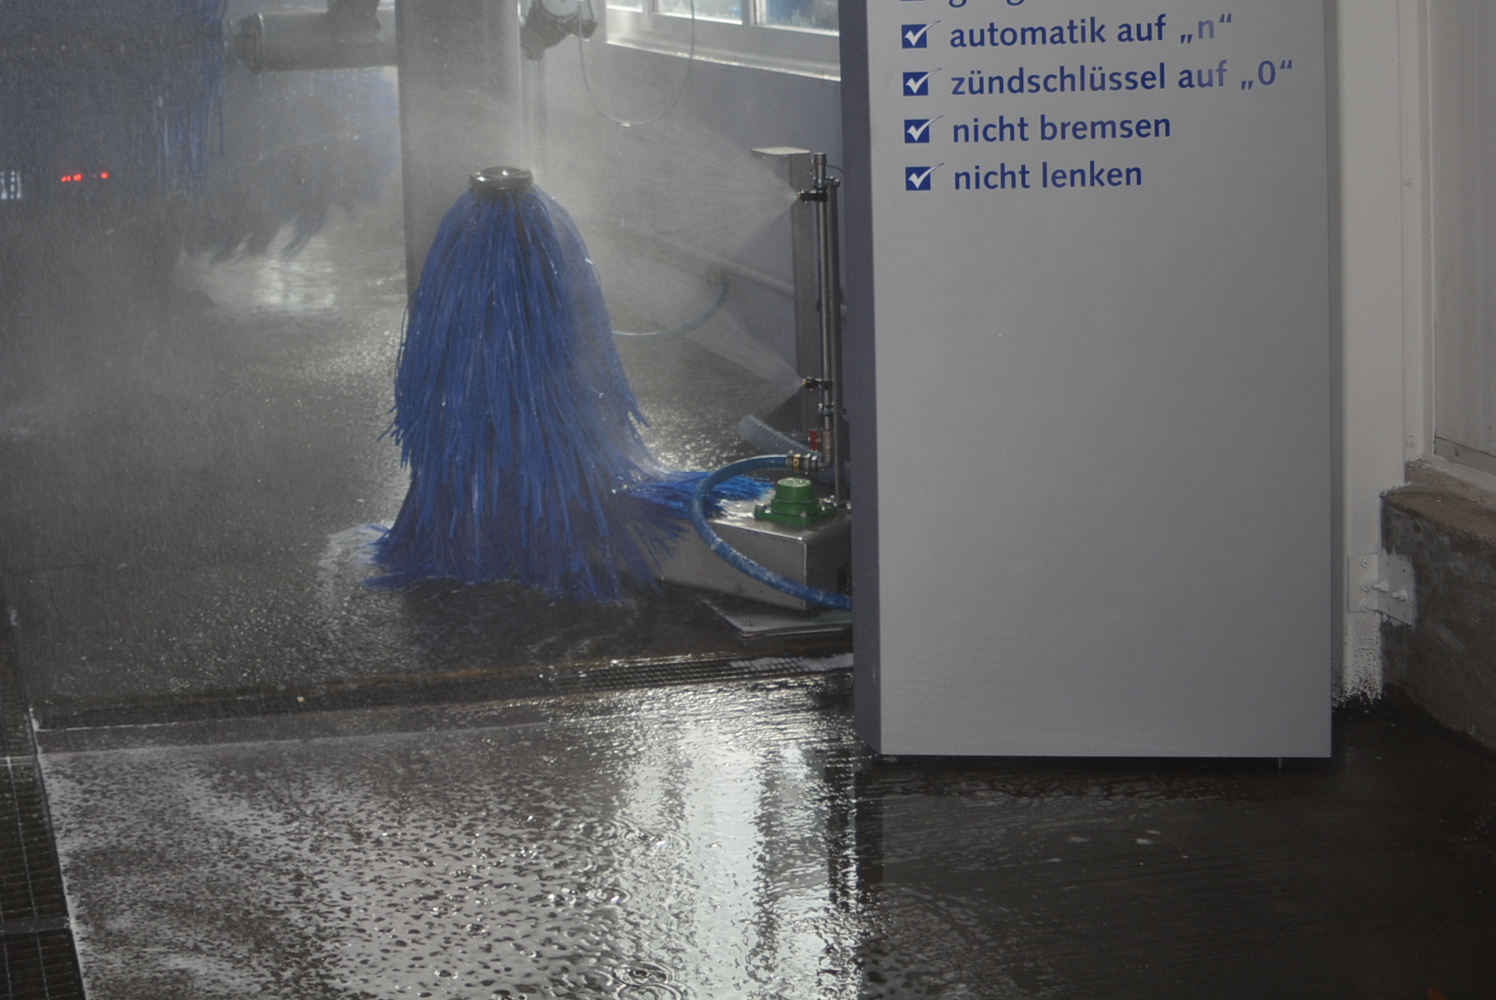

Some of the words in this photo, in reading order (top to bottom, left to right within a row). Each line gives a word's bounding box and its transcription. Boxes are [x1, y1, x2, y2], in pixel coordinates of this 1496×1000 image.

[949, 16, 1107, 48] automatik
[1117, 13, 1167, 42] auf
[951, 62, 1166, 96] zündschlüssel
[1177, 60, 1228, 89] auf
[952, 115, 1029, 143] nicht
[1039, 114, 1171, 141] bremsen
[953, 163, 1030, 191] nicht
[1042, 160, 1143, 188] lenken
